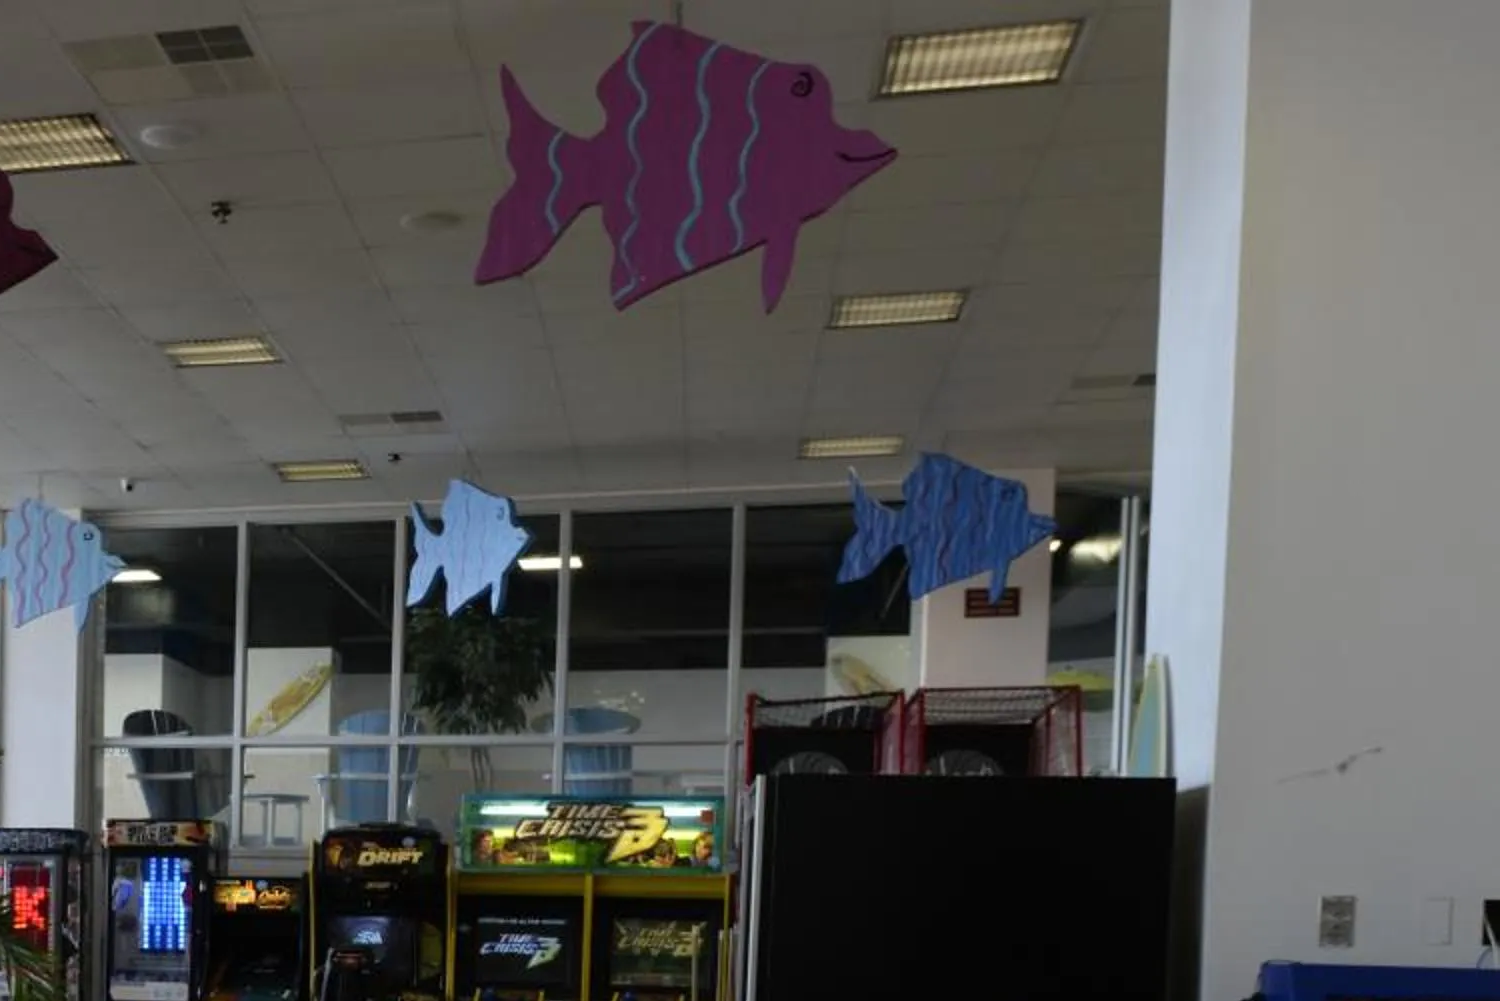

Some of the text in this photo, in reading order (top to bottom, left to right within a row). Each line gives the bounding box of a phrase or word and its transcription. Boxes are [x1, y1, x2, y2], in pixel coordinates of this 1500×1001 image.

[550, 804, 619, 819] TIME
[515, 808, 669, 862] CRISIS 3
[357, 850, 424, 867] DRIFT
